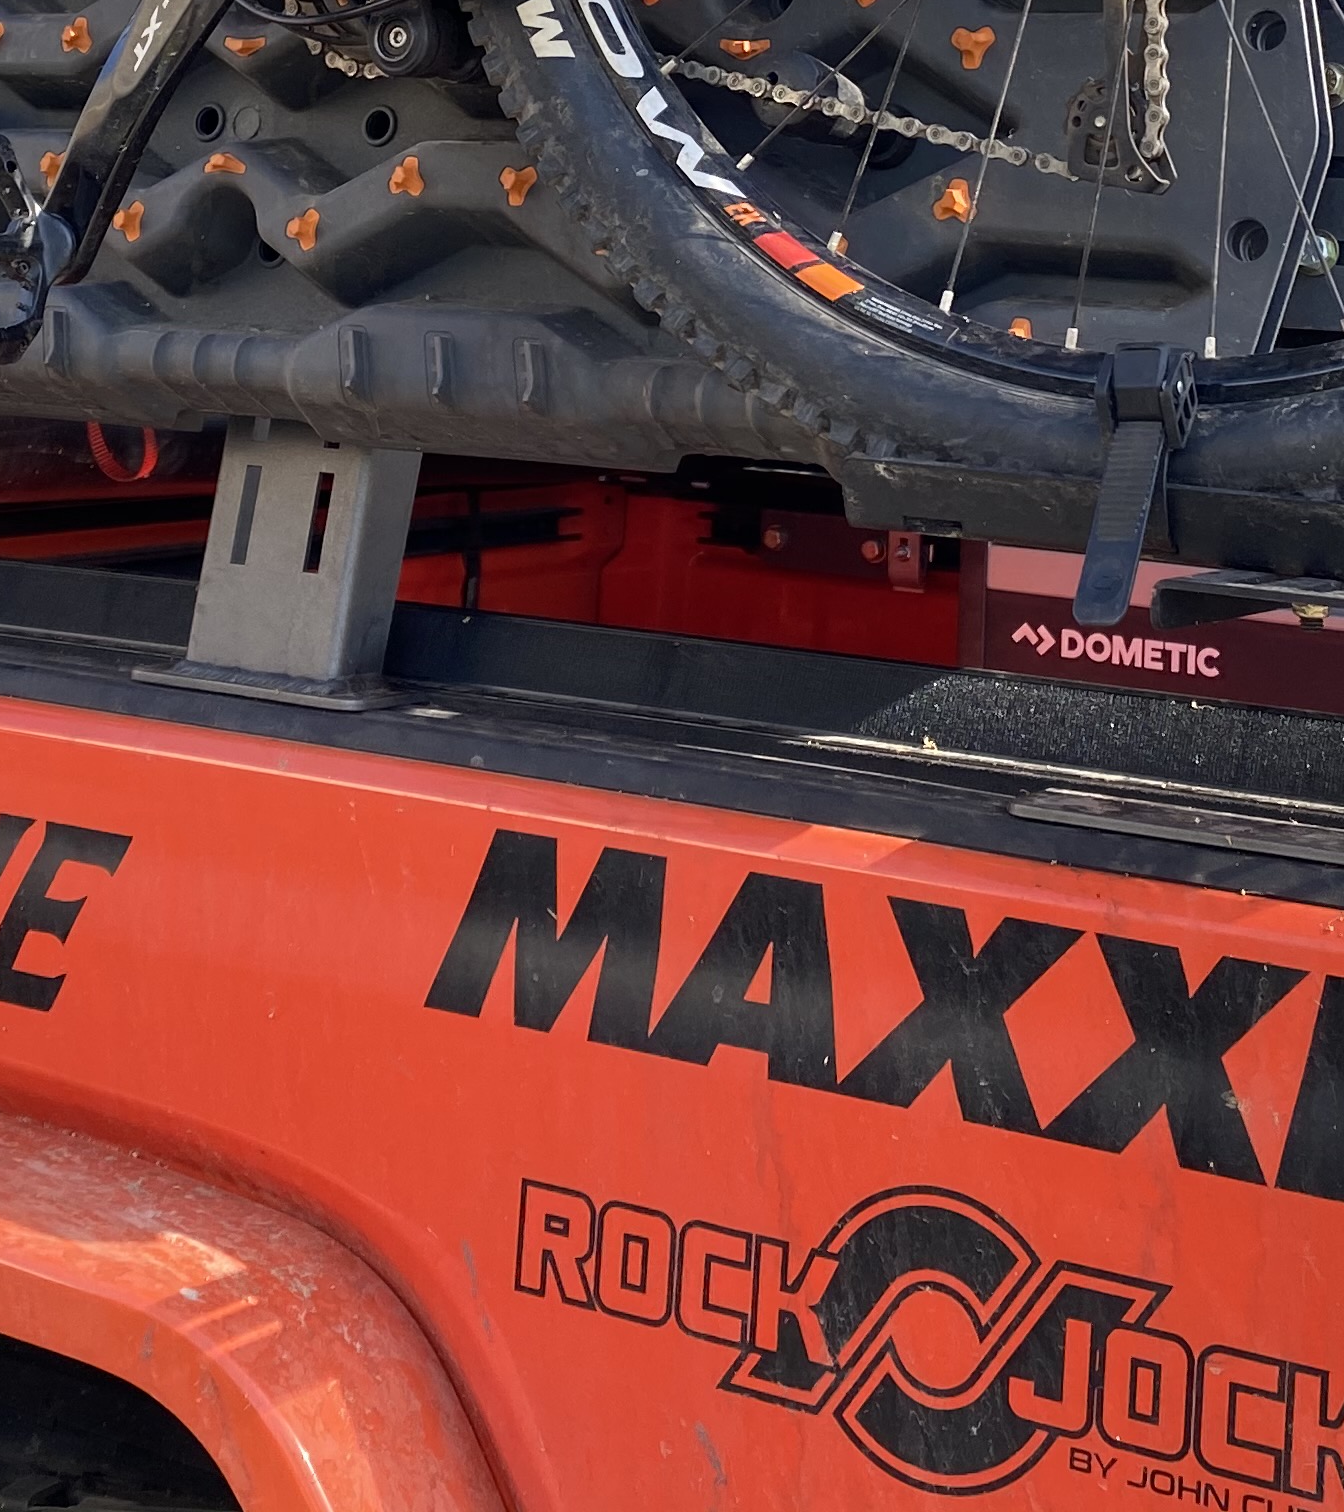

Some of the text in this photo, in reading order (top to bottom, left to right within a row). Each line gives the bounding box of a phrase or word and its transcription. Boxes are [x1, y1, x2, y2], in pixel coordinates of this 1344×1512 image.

[133, 5, 163, 72] XT
[1061, 628, 1220, 678] DOMETIC
[514, 1177, 846, 1415] ROCK
[1070, 1447, 1118, 1479] BY
[1127, 1466, 1229, 1512] JOHN
